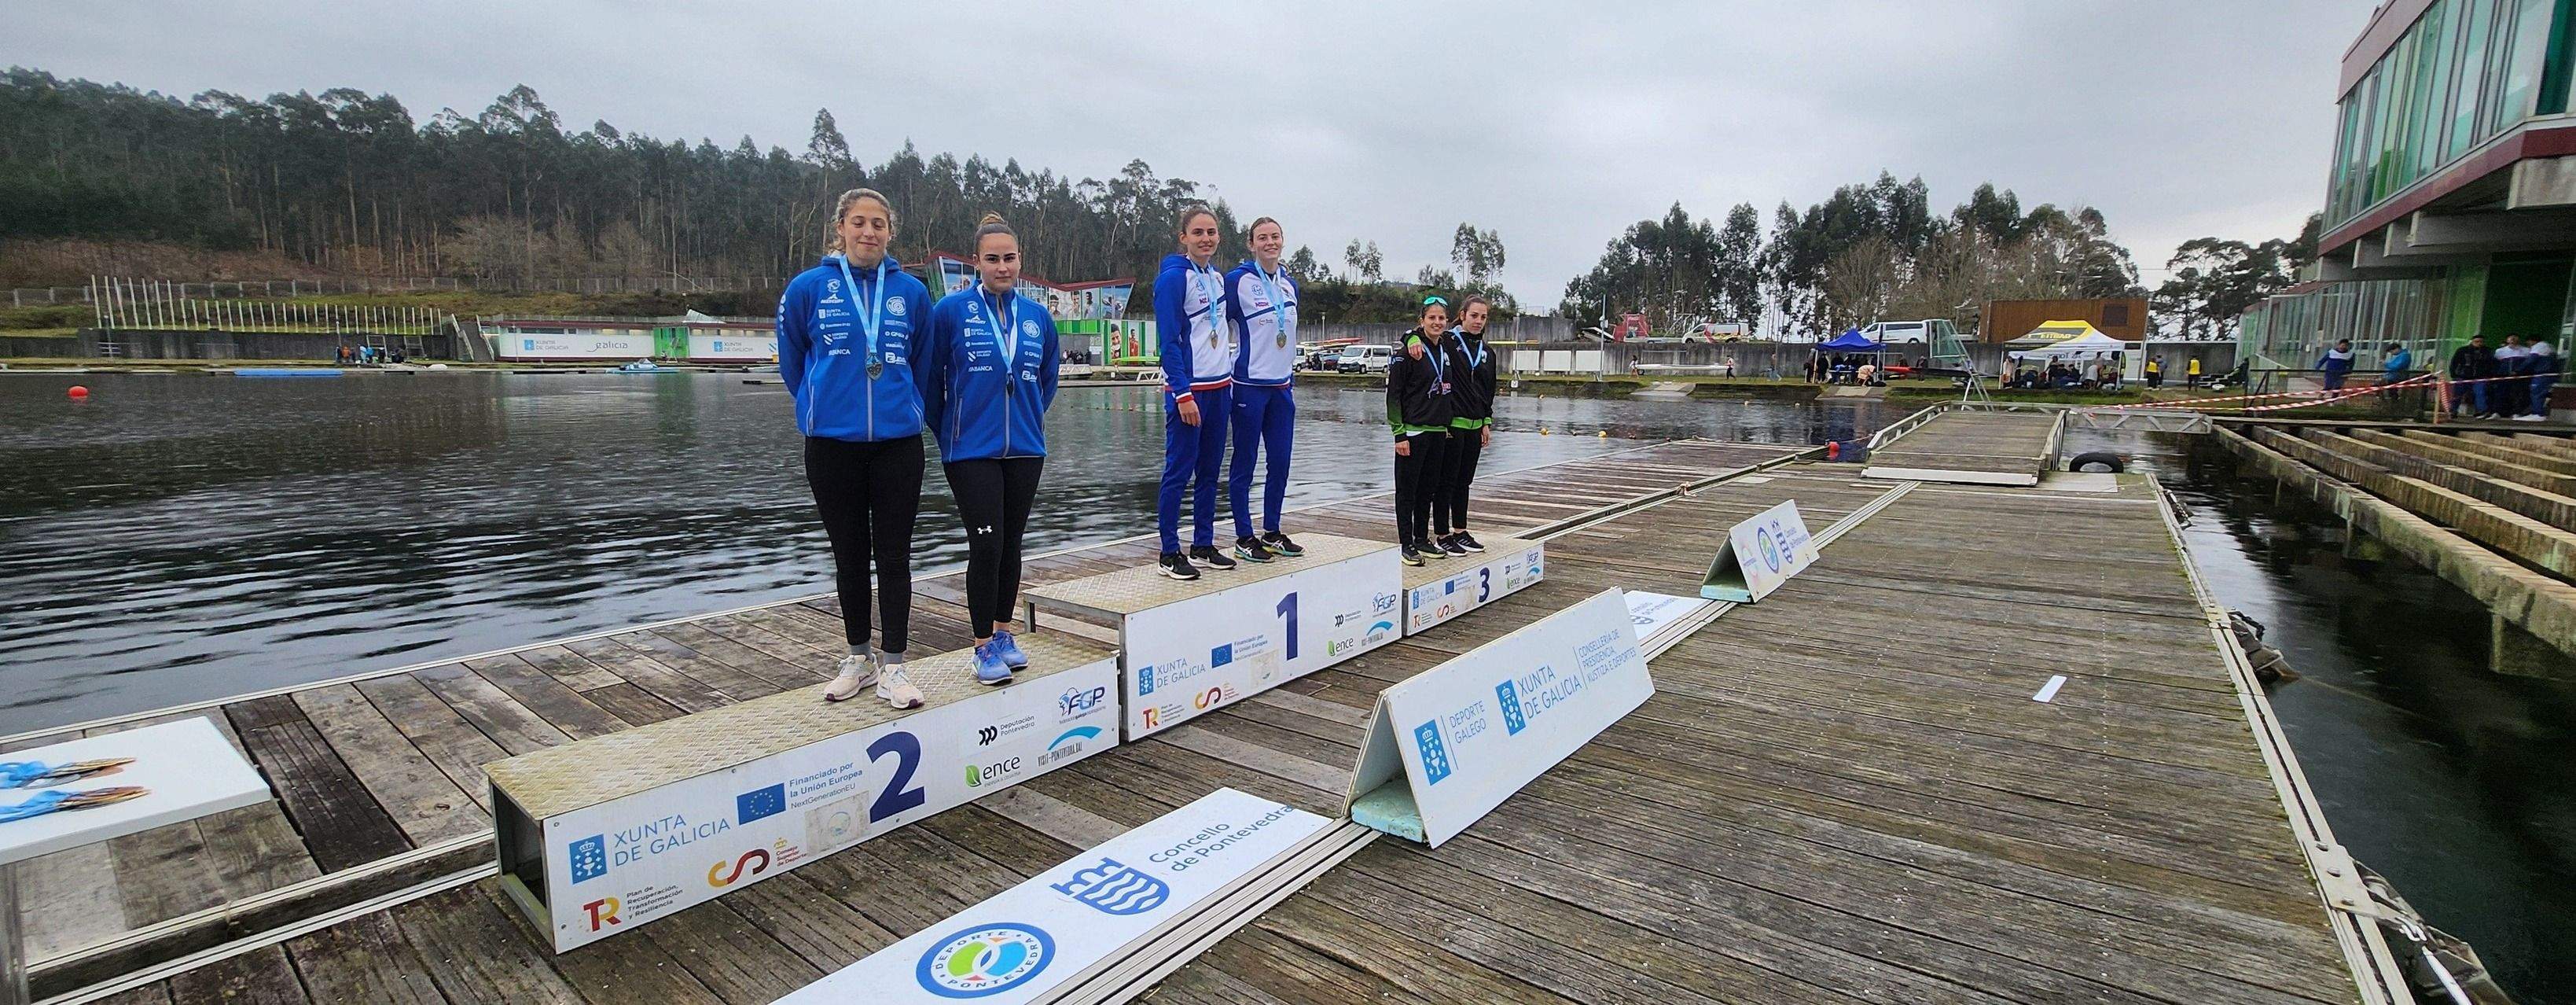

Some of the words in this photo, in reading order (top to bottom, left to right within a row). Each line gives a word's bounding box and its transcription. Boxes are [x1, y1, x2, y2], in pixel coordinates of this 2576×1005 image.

[586, 341, 628, 352] galicia
[1479, 567, 1490, 603] 3
[1276, 591, 1298, 661] 1
[1335, 638, 1354, 653] ence
[1612, 646, 1637, 668] DEPORTES
[1156, 658, 1188, 675] XUNTA
[1156, 677, 1169, 688] DE
[1172, 664, 1206, 683] GALICIA
[1517, 664, 1556, 698] XUNTA
[1068, 687, 1105, 715] FGP
[1524, 697, 1542, 720] DE
[1542, 675, 1582, 709] GALICIA
[1000, 715, 1034, 730] Deputación
[1450, 701, 1486, 728] DEPORTE
[1001, 722, 1035, 736] Pontevedra
[1454, 718, 1486, 744] GALEGO
[789, 767, 839, 787] Financiado
[840, 762, 854, 775] por
[865, 731, 925, 824] 2
[983, 756, 1020, 780] ence
[790, 790, 798, 798] la
[800, 781, 827, 794] Unión
[829, 769, 863, 786] Europea
[791, 782, 856, 809] NextGenerationEU
[614, 814, 686, 848] XUNTA
[616, 845, 642, 867] DE
[650, 818, 730, 855] GALICIA
[1149, 823, 1229, 863] Concello
[1170, 855, 1200, 872] de
[1199, 804, 1295, 858] Pontevedra
[627, 889, 642, 898] Plan
[627, 885, 678, 905] Recuperación,
[628, 889, 683, 912] Transformación
[635, 900, 674, 917] Resiliencia
[935, 930, 1009, 970] DEPORTE
[947, 937, 1039, 988] PONTEVEDRA
